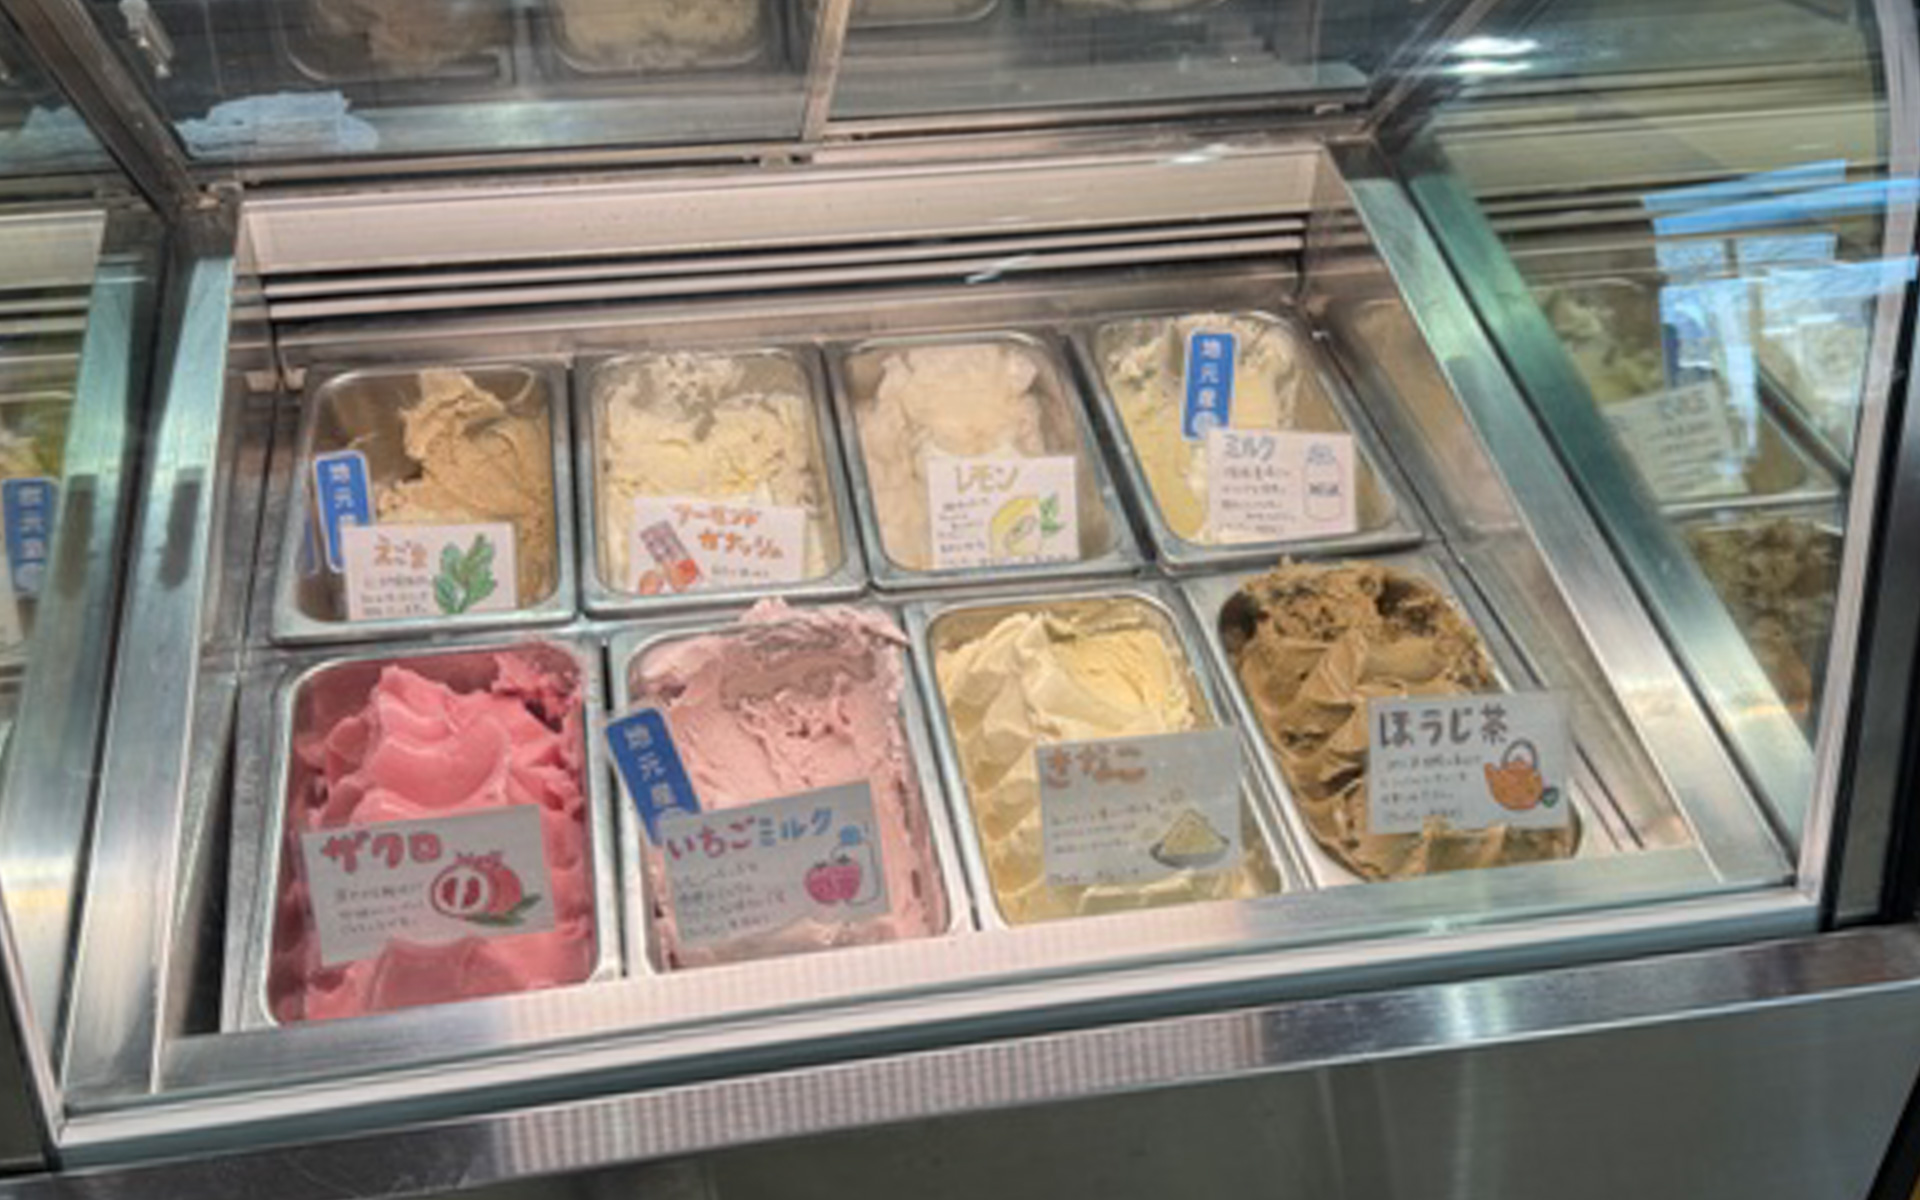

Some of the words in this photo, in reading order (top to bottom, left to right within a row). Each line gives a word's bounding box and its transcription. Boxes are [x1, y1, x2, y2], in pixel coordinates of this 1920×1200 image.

[1222, 433, 1275, 461] ミルク
[954, 463, 1019, 493] レモン
[373, 534, 428, 568] えごま
[1379, 703, 1508, 748] ほうじ茶
[1046, 743, 1146, 788] きなこ
[321, 830, 443, 874] ザクロ
[665, 806, 832, 860] いちごミルク
